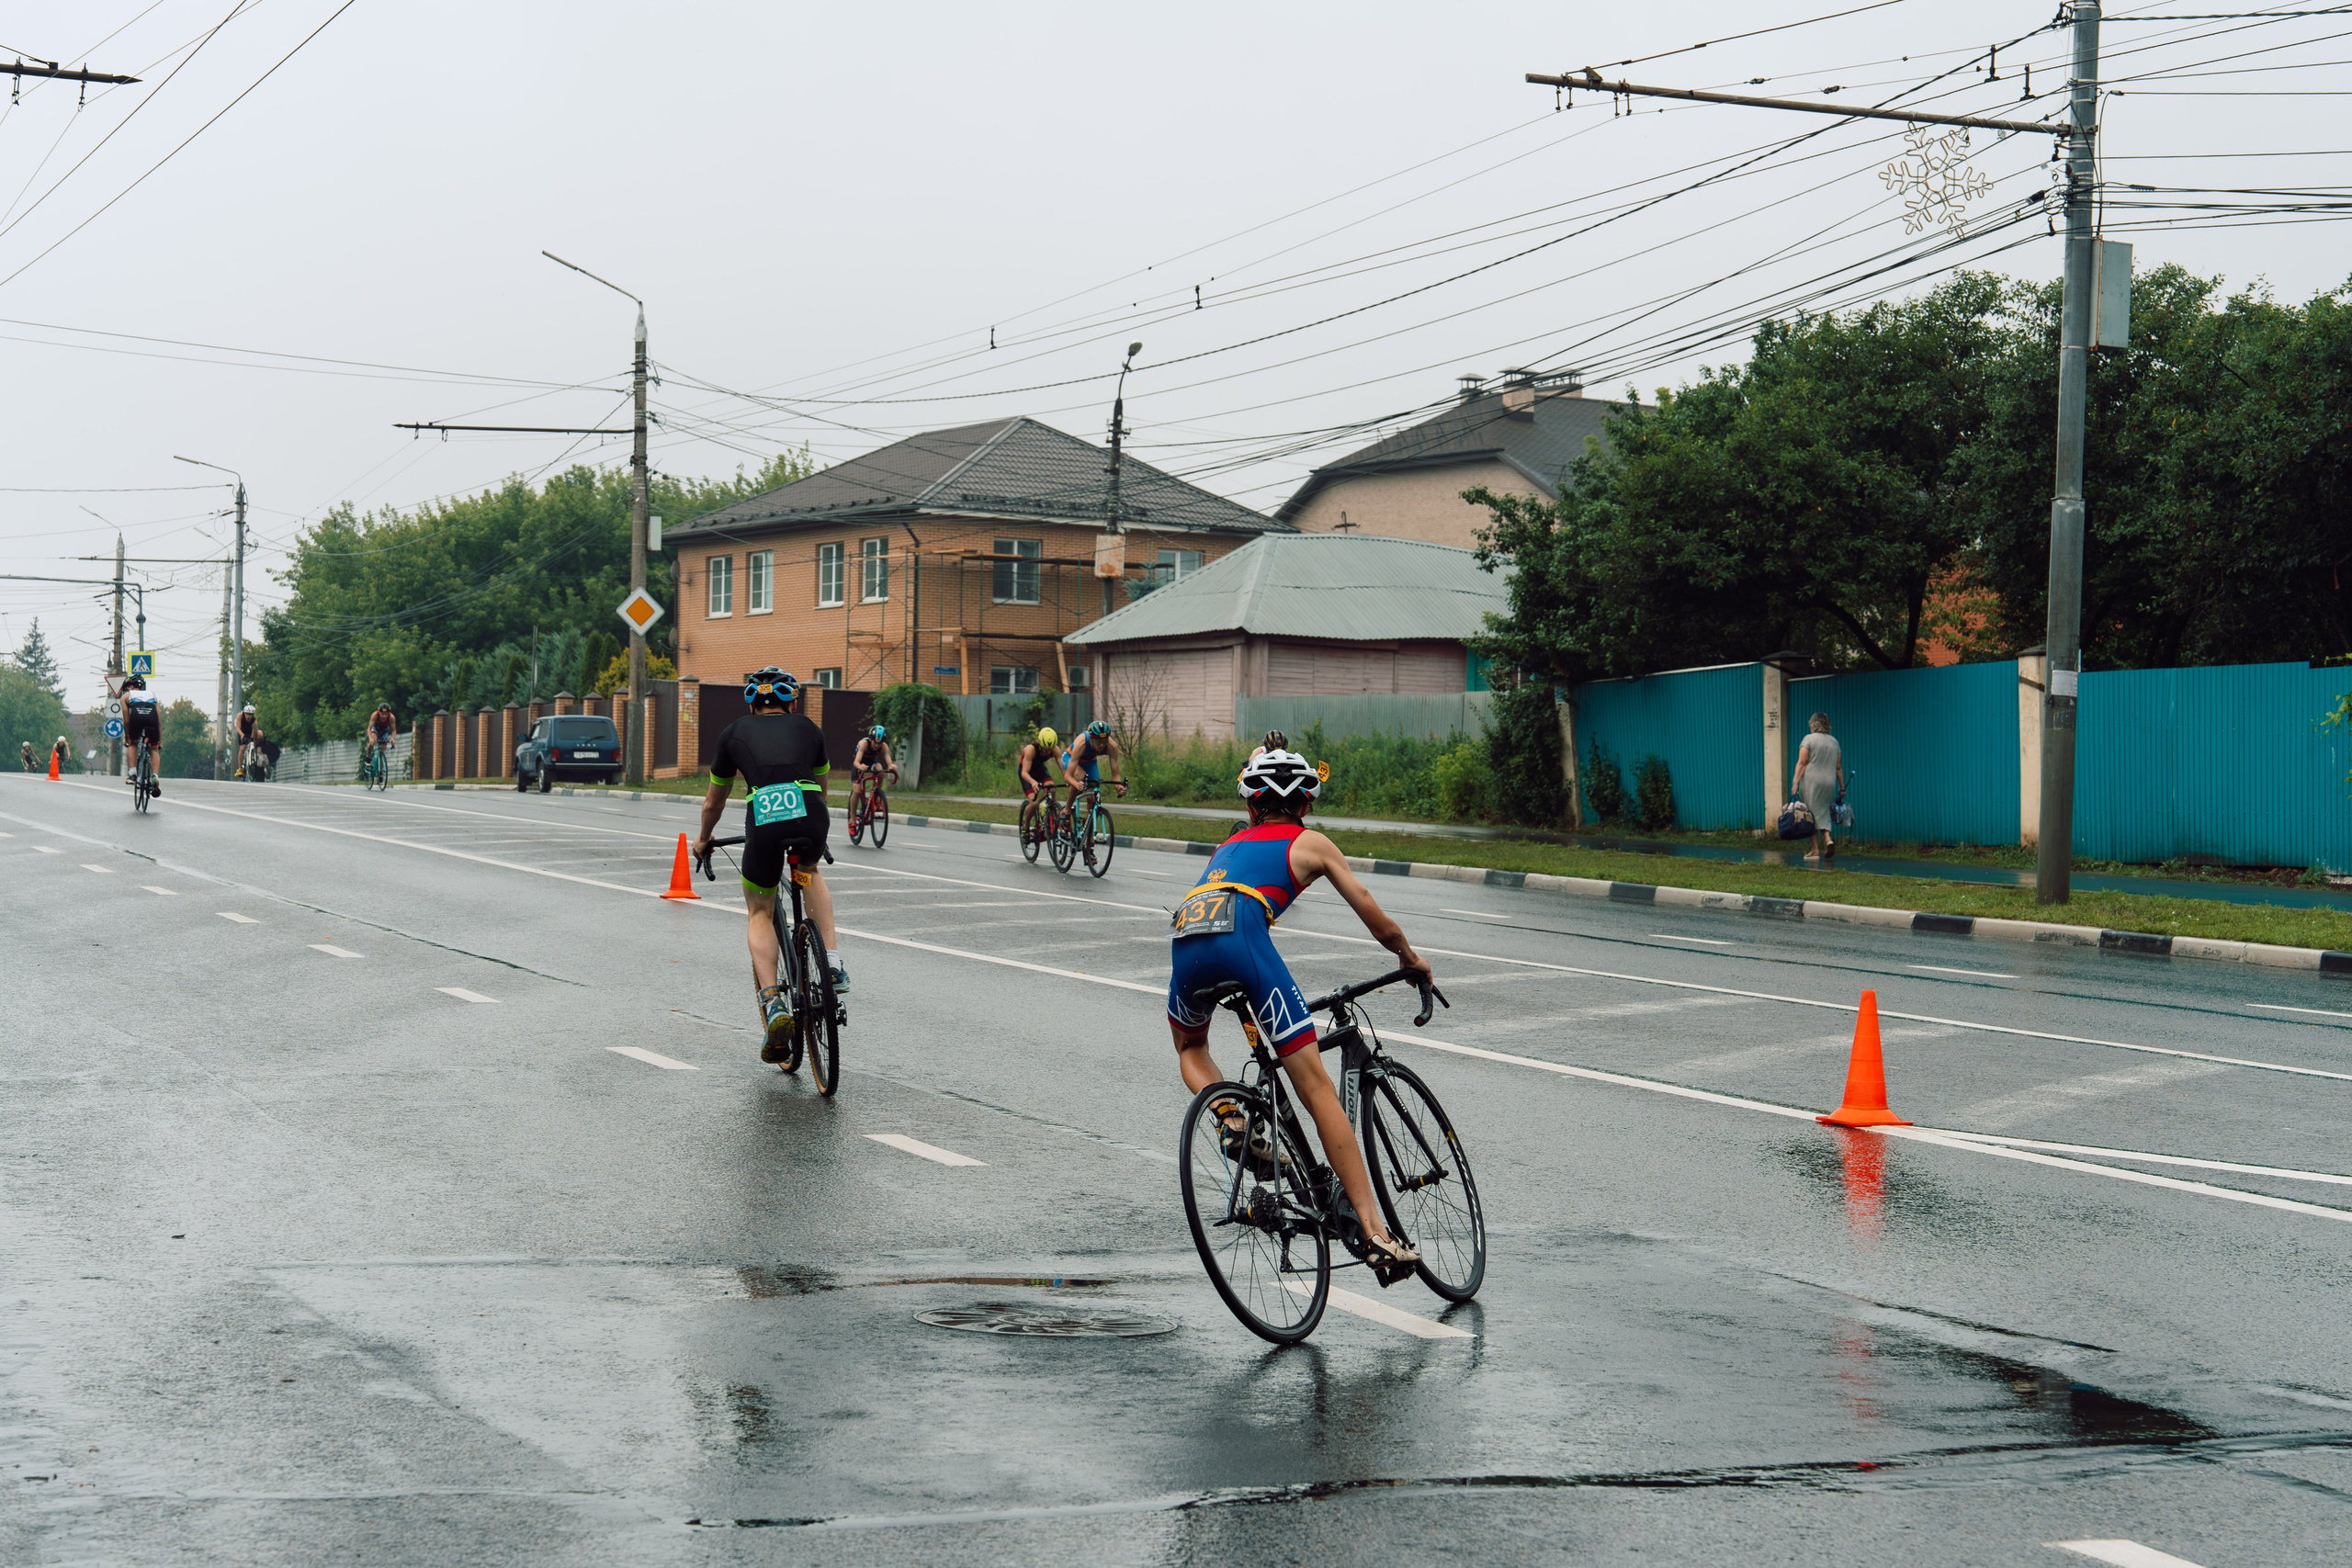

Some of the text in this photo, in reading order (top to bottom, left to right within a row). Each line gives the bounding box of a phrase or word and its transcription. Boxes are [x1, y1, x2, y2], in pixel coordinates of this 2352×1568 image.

[1317, 762, 1328, 778] 437
[758, 790, 797, 814] 320
[797, 873, 808, 884] 320
[1175, 897, 1225, 931] 437
[1291, 985, 1308, 1015] TITAN
